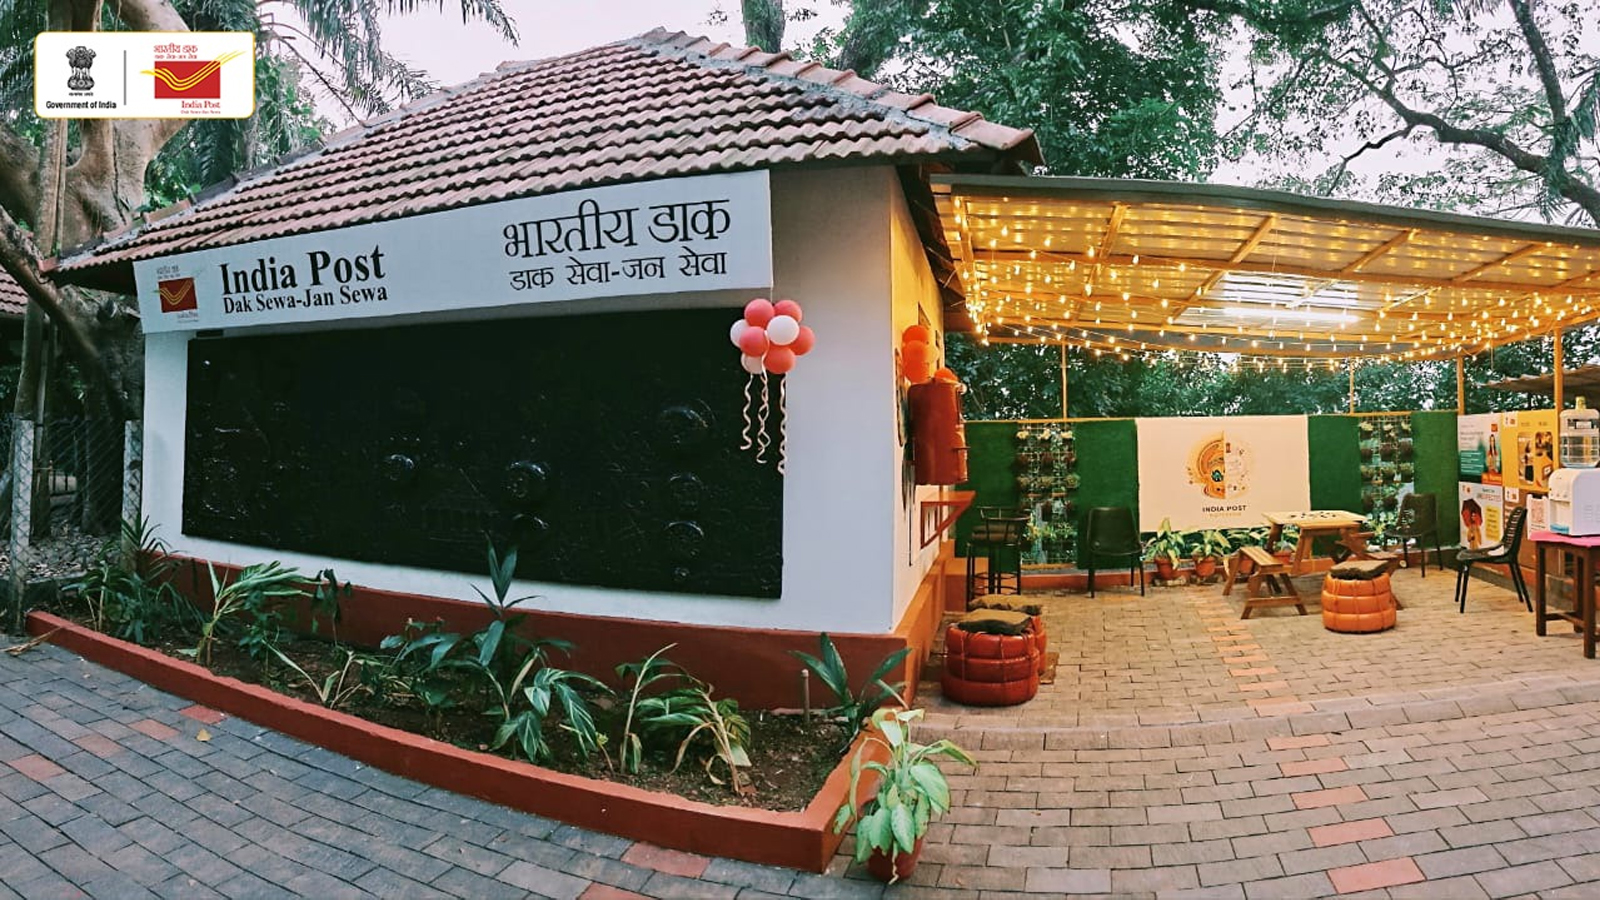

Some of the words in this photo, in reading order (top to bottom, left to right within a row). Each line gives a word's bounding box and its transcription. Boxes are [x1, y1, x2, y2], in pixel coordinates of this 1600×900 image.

[503, 199, 640, 259] भारतीय
[648, 199, 731, 243] डाक
[219, 257, 299, 296] India
[306, 245, 386, 286] Post
[509, 266, 554, 291] डाक
[565, 256, 666, 285] सेवा-जन
[679, 246, 728, 277] सेवा
[224, 297, 252, 314] Dak
[255, 289, 335, 312] Sewa-Jan
[340, 286, 389, 305] Sewa
[1227, 504, 1247, 512] POST
